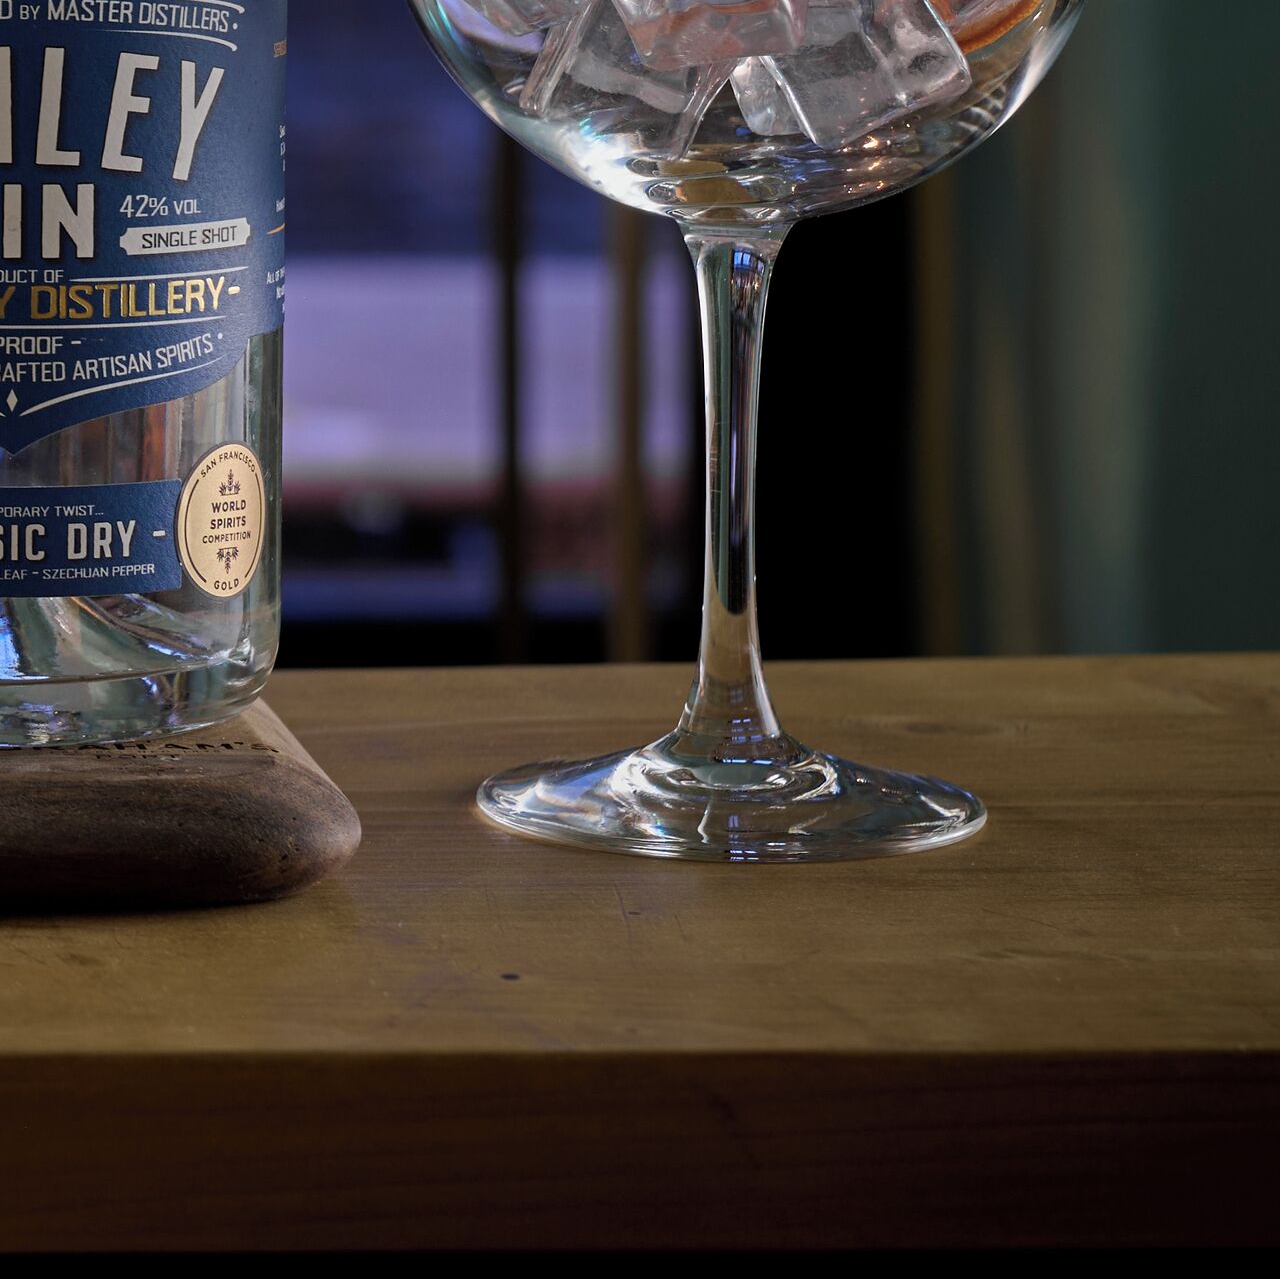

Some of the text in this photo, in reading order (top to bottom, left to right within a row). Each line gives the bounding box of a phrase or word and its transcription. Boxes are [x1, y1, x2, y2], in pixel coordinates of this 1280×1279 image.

[47, 0, 134, 25] MASTER
[139, 2, 229, 33] DISTILLERS
[120, 195, 201, 217] 42% VOL
[141, 226, 237, 248] SINGLE SHOT
[43, 269, 64, 283] OF
[31, 277, 222, 319] DISTILLERY
[72, 350, 151, 380] ARTISAN
[157, 333, 213, 367] SPIRITS
[200, 452, 257, 478] SAN FRANCISCO
[211, 499, 246, 514] WORLD
[209, 516, 246, 530] SPIRITS
[68, 520, 136, 560] DRY
[202, 530, 252, 545] COMPETITION
[42, 566, 109, 580] SZECHUAN
[112, 563, 155, 577] PEPPER
[213, 578, 240, 591] GOLD
